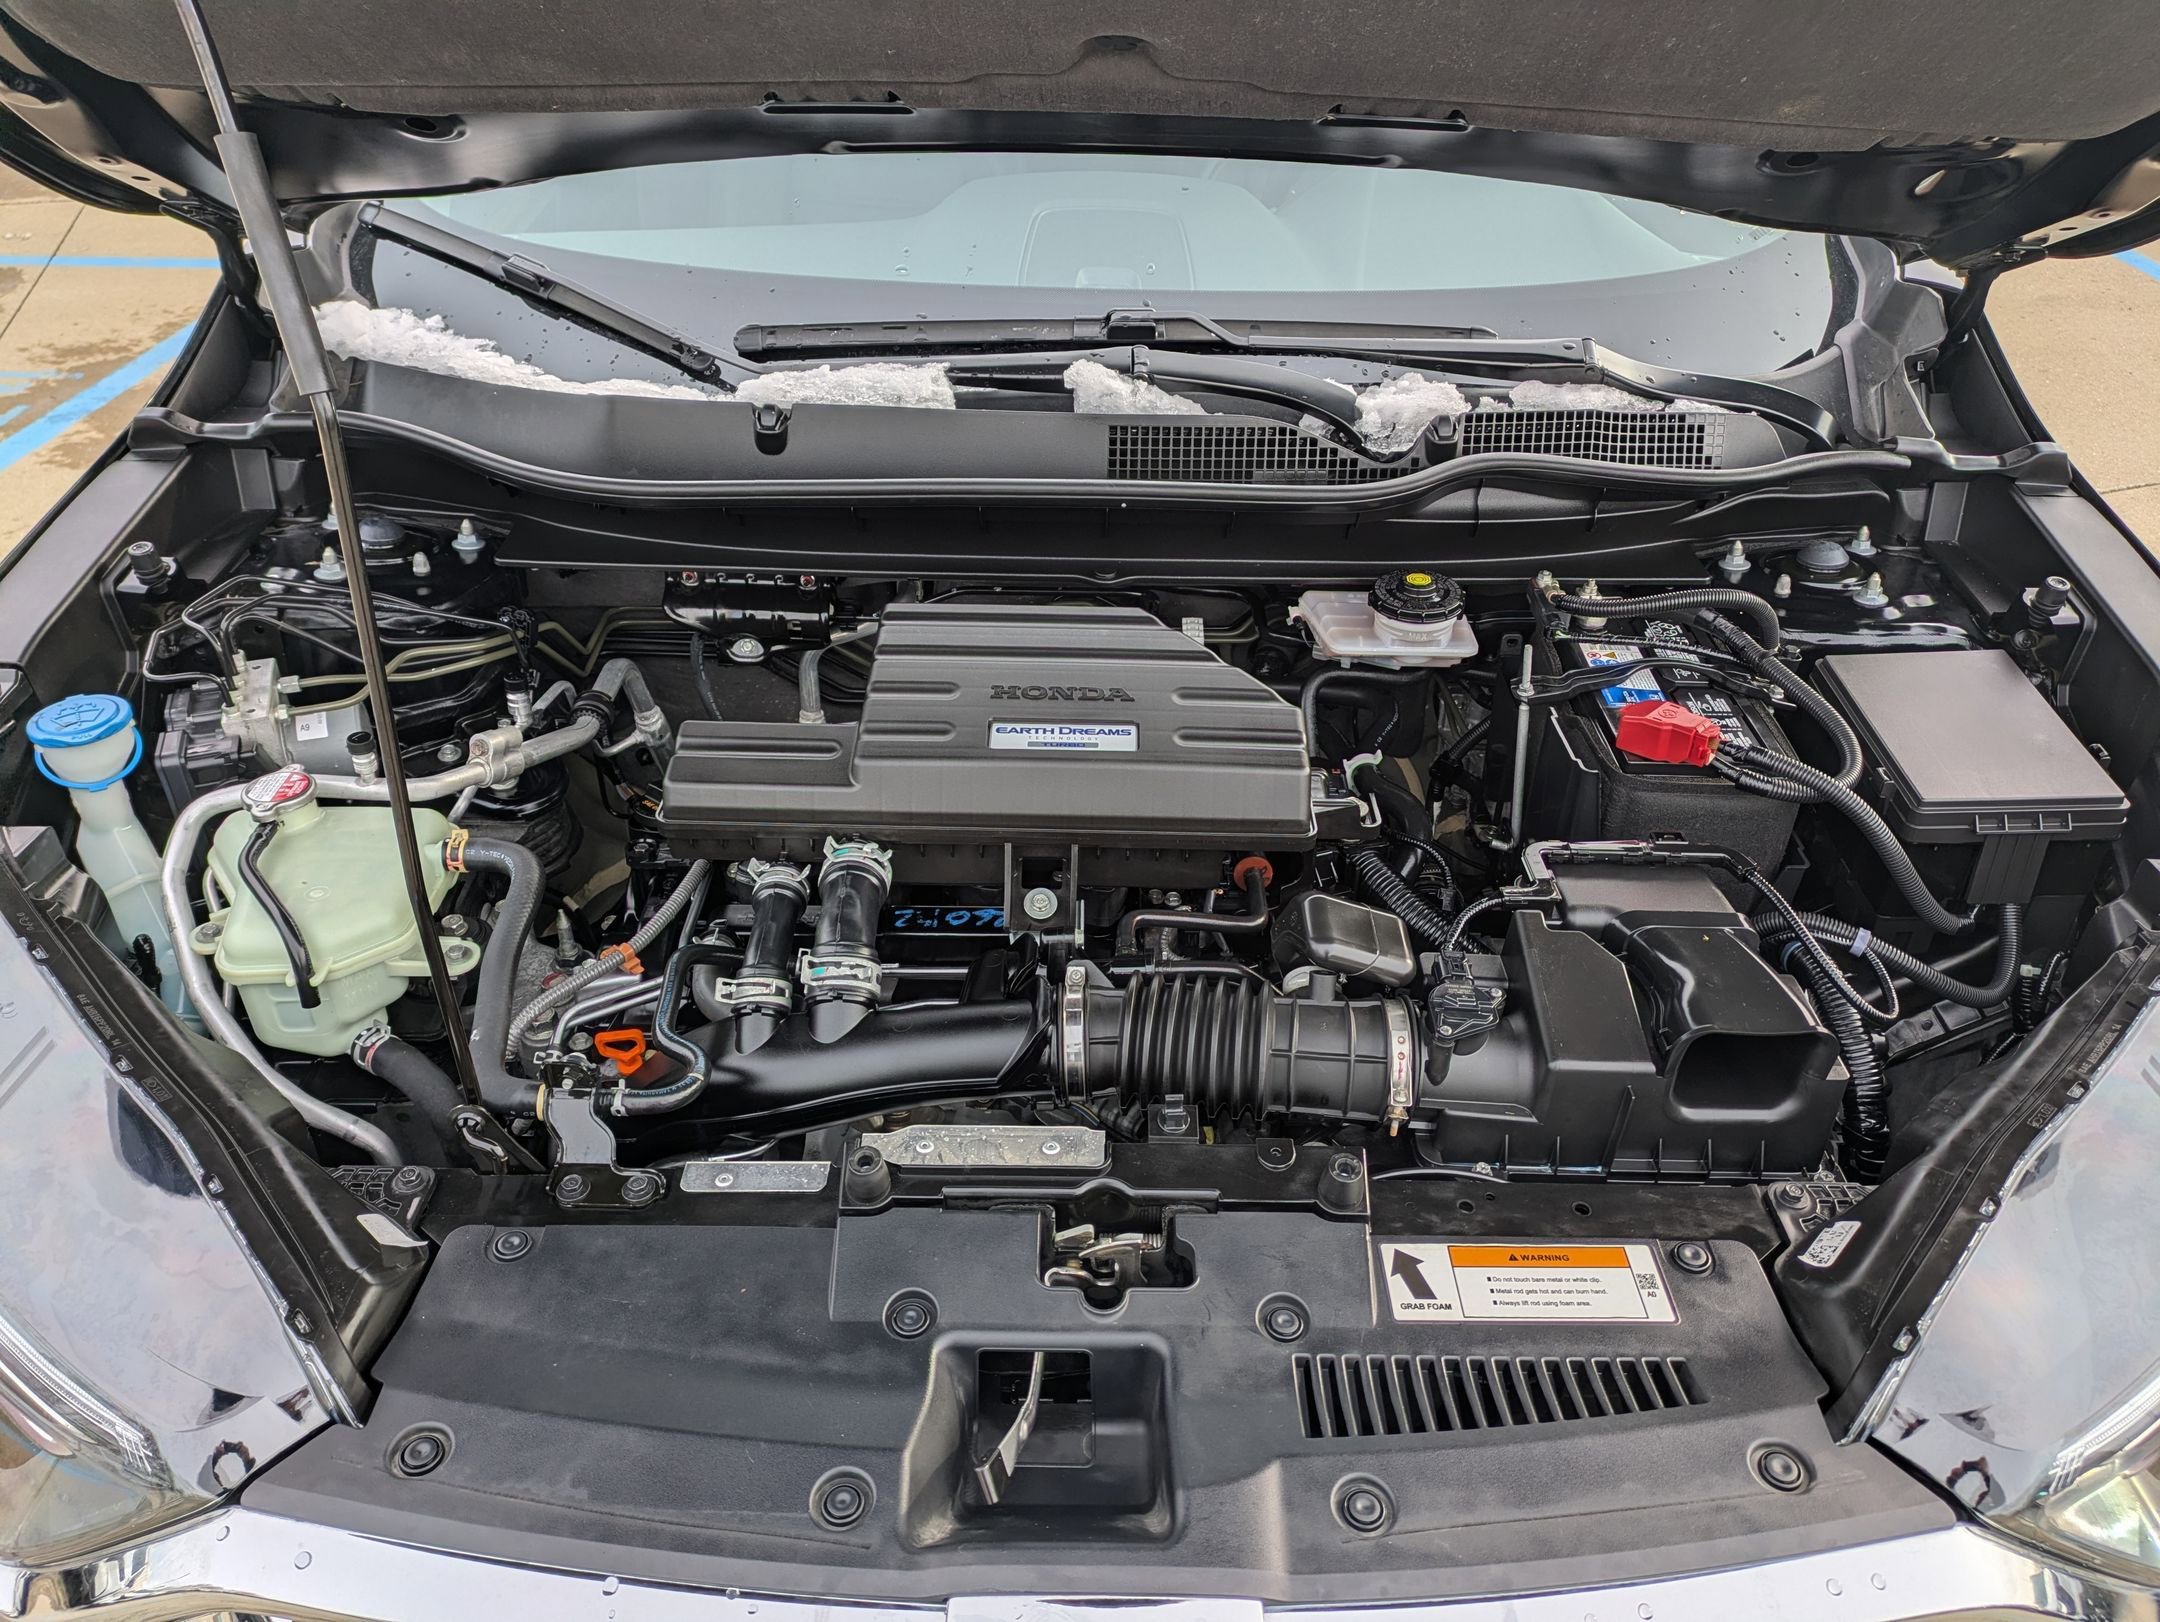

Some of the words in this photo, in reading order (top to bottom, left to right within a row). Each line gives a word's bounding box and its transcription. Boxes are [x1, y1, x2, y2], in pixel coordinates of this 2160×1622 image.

[990, 685, 1135, 702] HONDA
[995, 726, 1055, 735] EARTH
[1058, 726, 1132, 736] DREAMS
[1519, 1254, 1570, 1262] WARNING
[1531, 1276, 1546, 1284] bare
[1589, 1276, 1602, 1284] clip.
[1525, 1288, 1538, 1296] gets
[1400, 1303, 1426, 1311] GRAB
[1427, 1303, 1453, 1311] FOAM
[1499, 1300, 1520, 1308] Always
[1541, 1300, 1558, 1308] using
